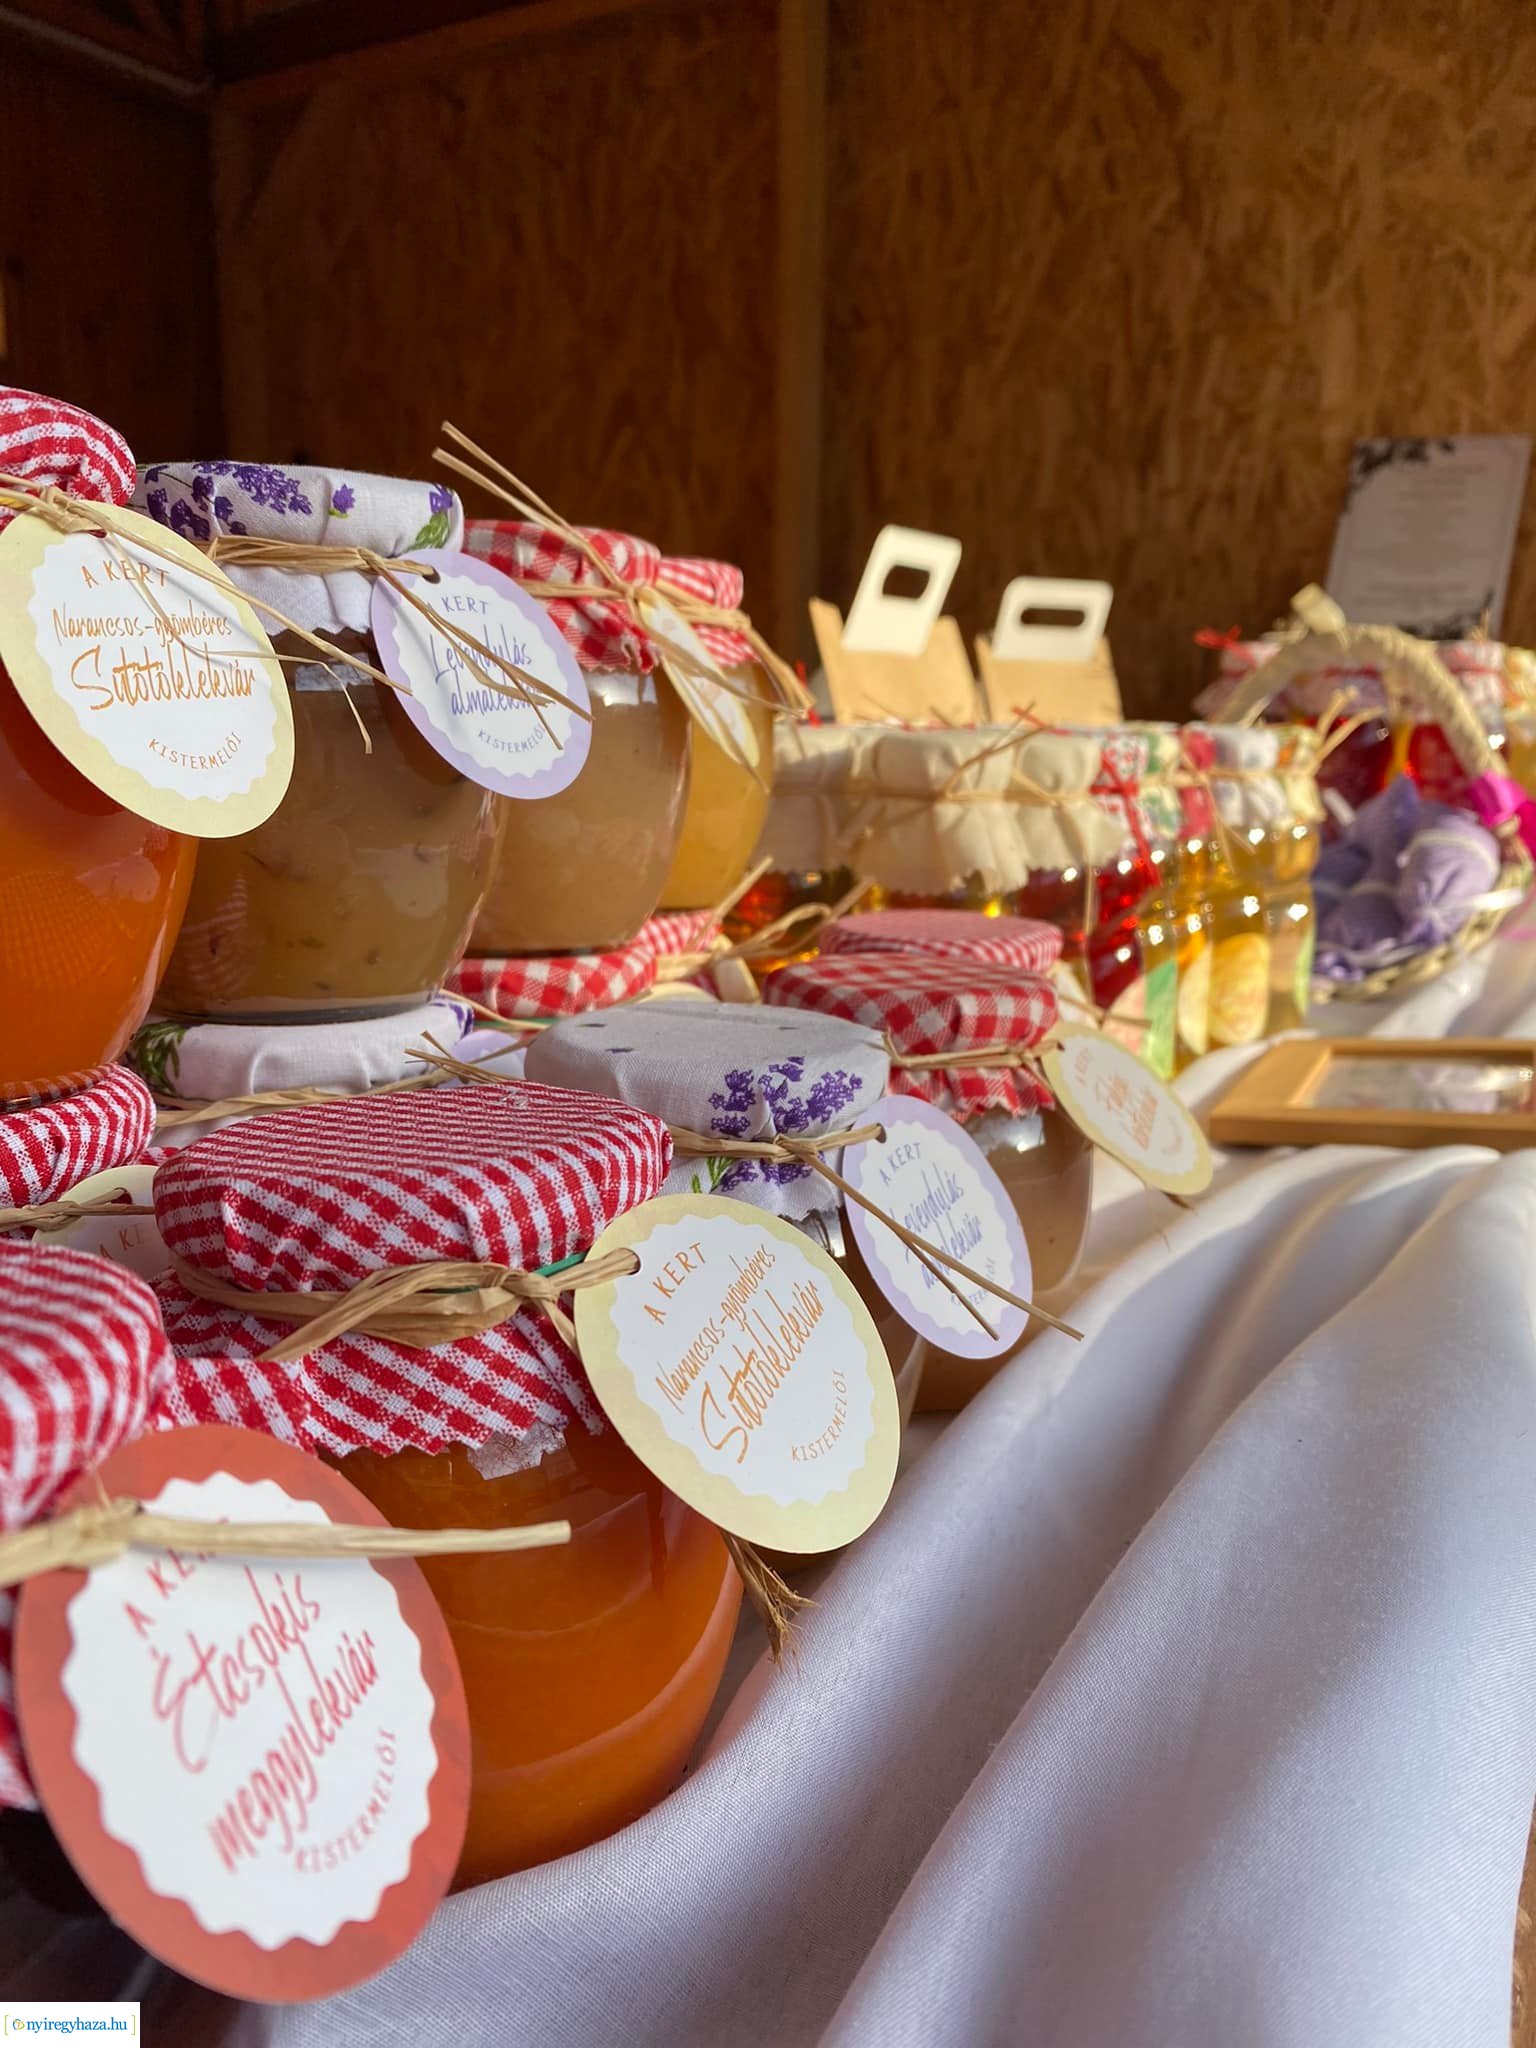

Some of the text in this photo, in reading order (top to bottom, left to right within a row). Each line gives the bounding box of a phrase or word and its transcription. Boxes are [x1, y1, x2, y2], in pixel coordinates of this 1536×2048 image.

[81, 559, 170, 589] A KERT
[441, 595, 489, 615] KERT
[878, 1141, 922, 1187] A KERT
[643, 1242, 707, 1325] A KERT
[124, 1602, 155, 1640] A
